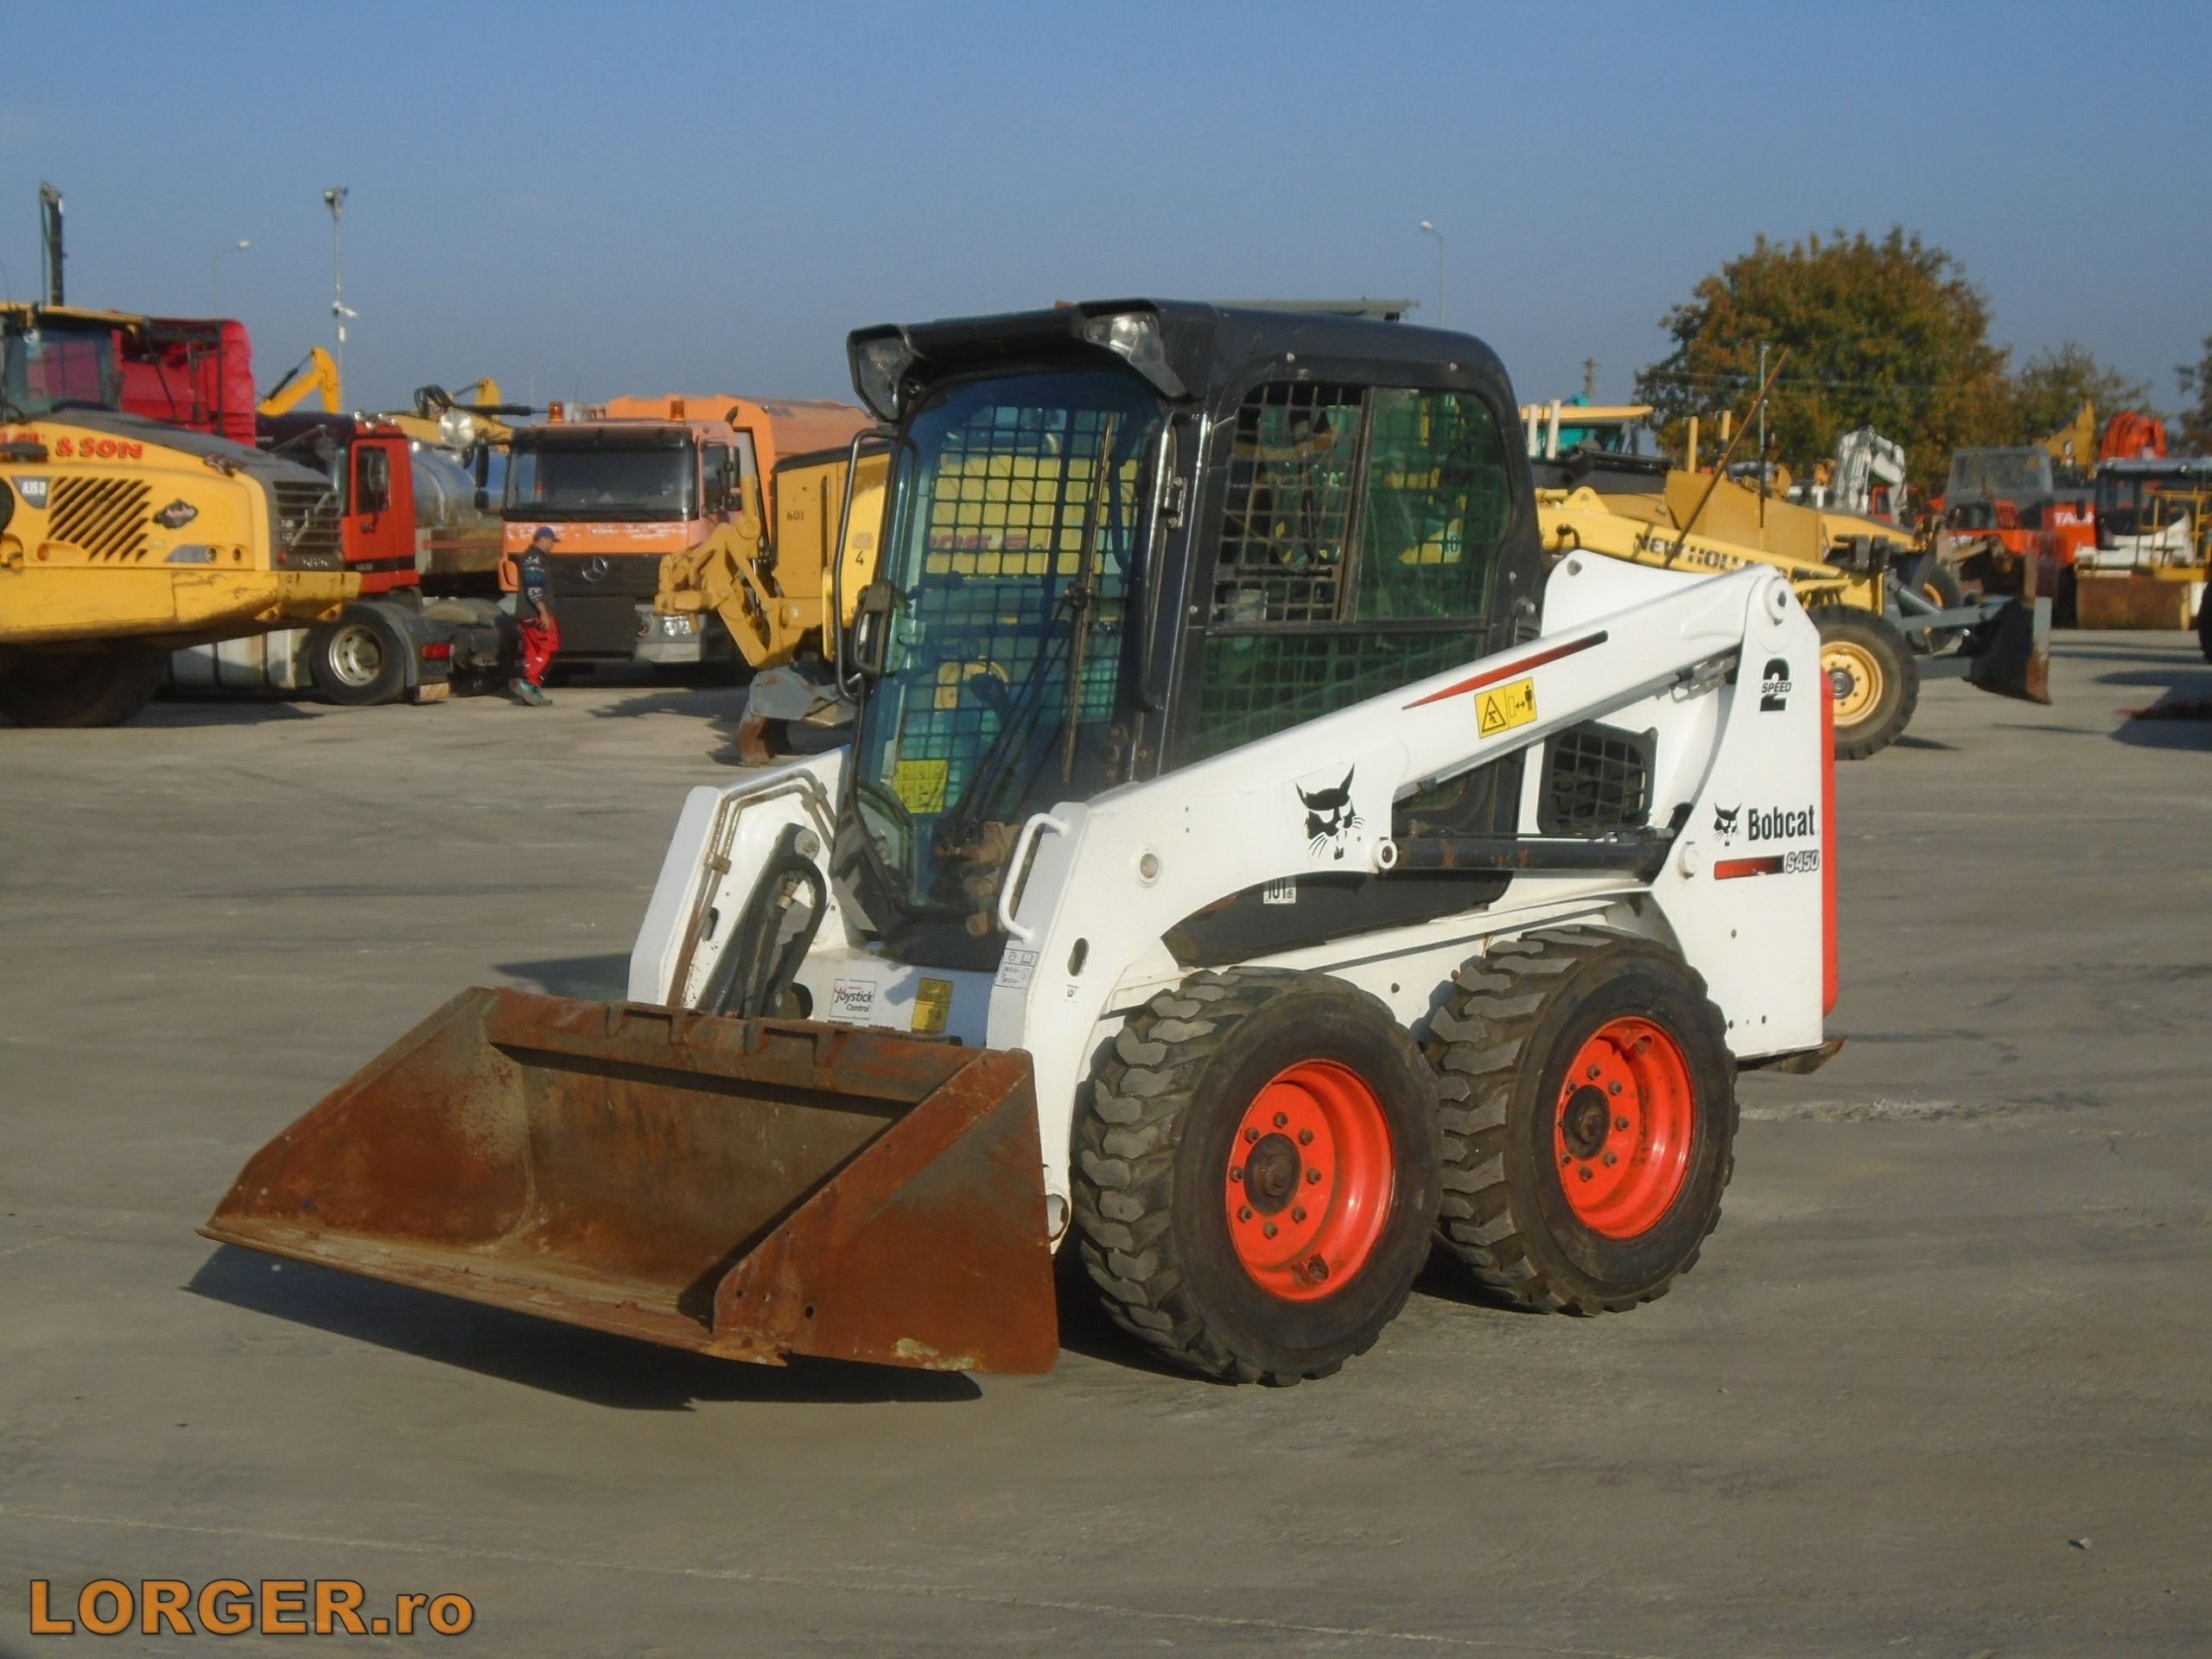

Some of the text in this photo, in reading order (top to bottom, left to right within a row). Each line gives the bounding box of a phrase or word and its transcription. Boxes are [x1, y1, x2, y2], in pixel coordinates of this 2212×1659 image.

[56, 437, 74, 456] &
[79, 437, 143, 459] SON
[855, 550, 864, 566] 4
[1688, 545, 1789, 577] HOLL
[1760, 658, 1789, 712] 2
[1761, 681, 1792, 694] SPEED
[1748, 804, 1815, 841] Bobcat
[1785, 849, 1820, 874] S450
[846, 1003, 870, 1013] Control
